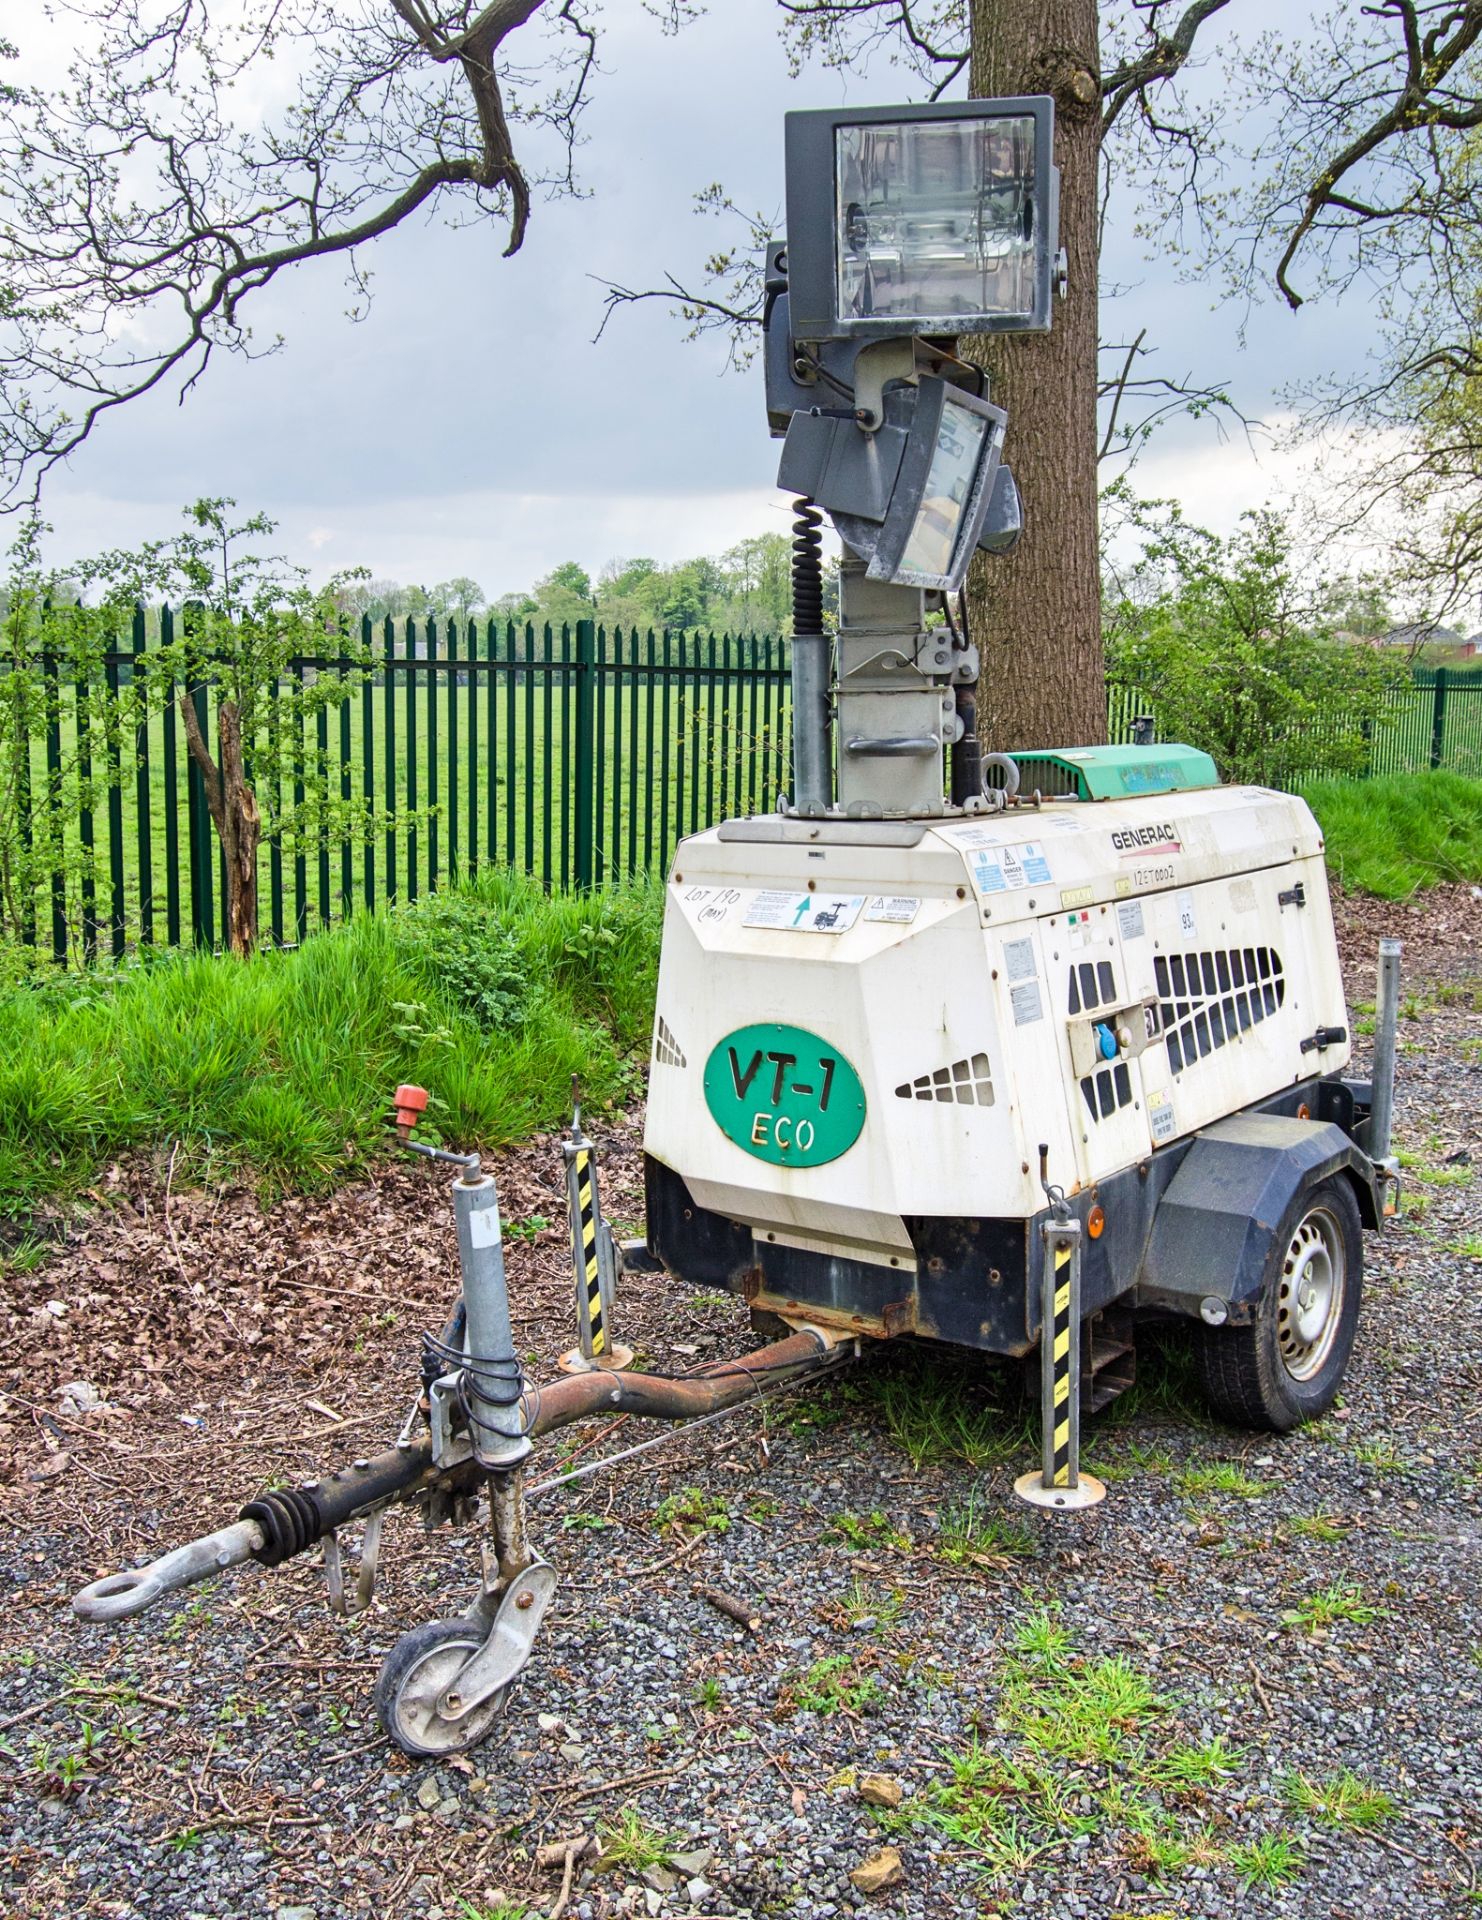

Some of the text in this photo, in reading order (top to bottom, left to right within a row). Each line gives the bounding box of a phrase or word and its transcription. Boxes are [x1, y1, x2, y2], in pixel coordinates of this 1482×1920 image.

[1111, 823, 1175, 850] GENERAC
[683, 886, 741, 905] LOT 190
[727, 1045, 836, 1113] VT-1
[750, 1112, 815, 1151] ECO
